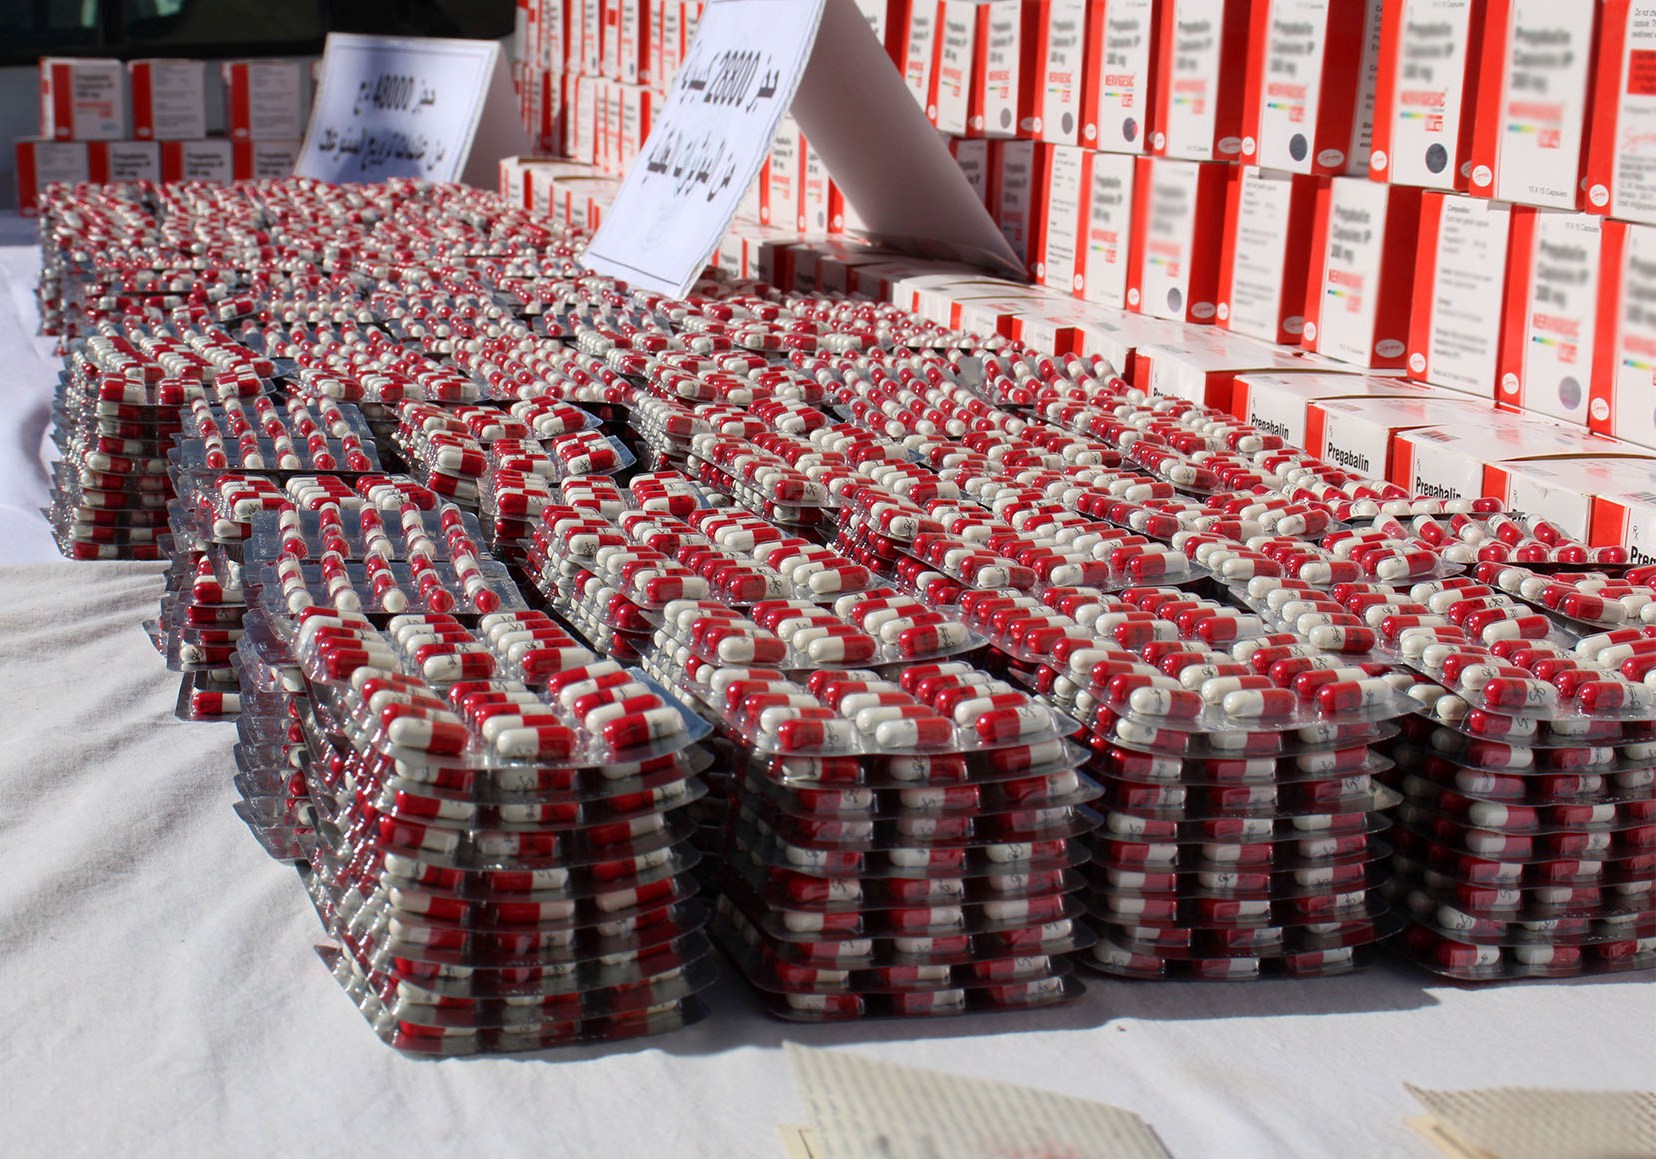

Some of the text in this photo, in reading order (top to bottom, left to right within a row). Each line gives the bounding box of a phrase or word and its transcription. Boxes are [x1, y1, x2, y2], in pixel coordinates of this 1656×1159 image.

[703, 50, 761, 108] 28800
[1251, 412, 1289, 440] Pregabalin
[1327, 441, 1369, 472] Pregabalin
[1415, 476, 1462, 499] Pregabalin
